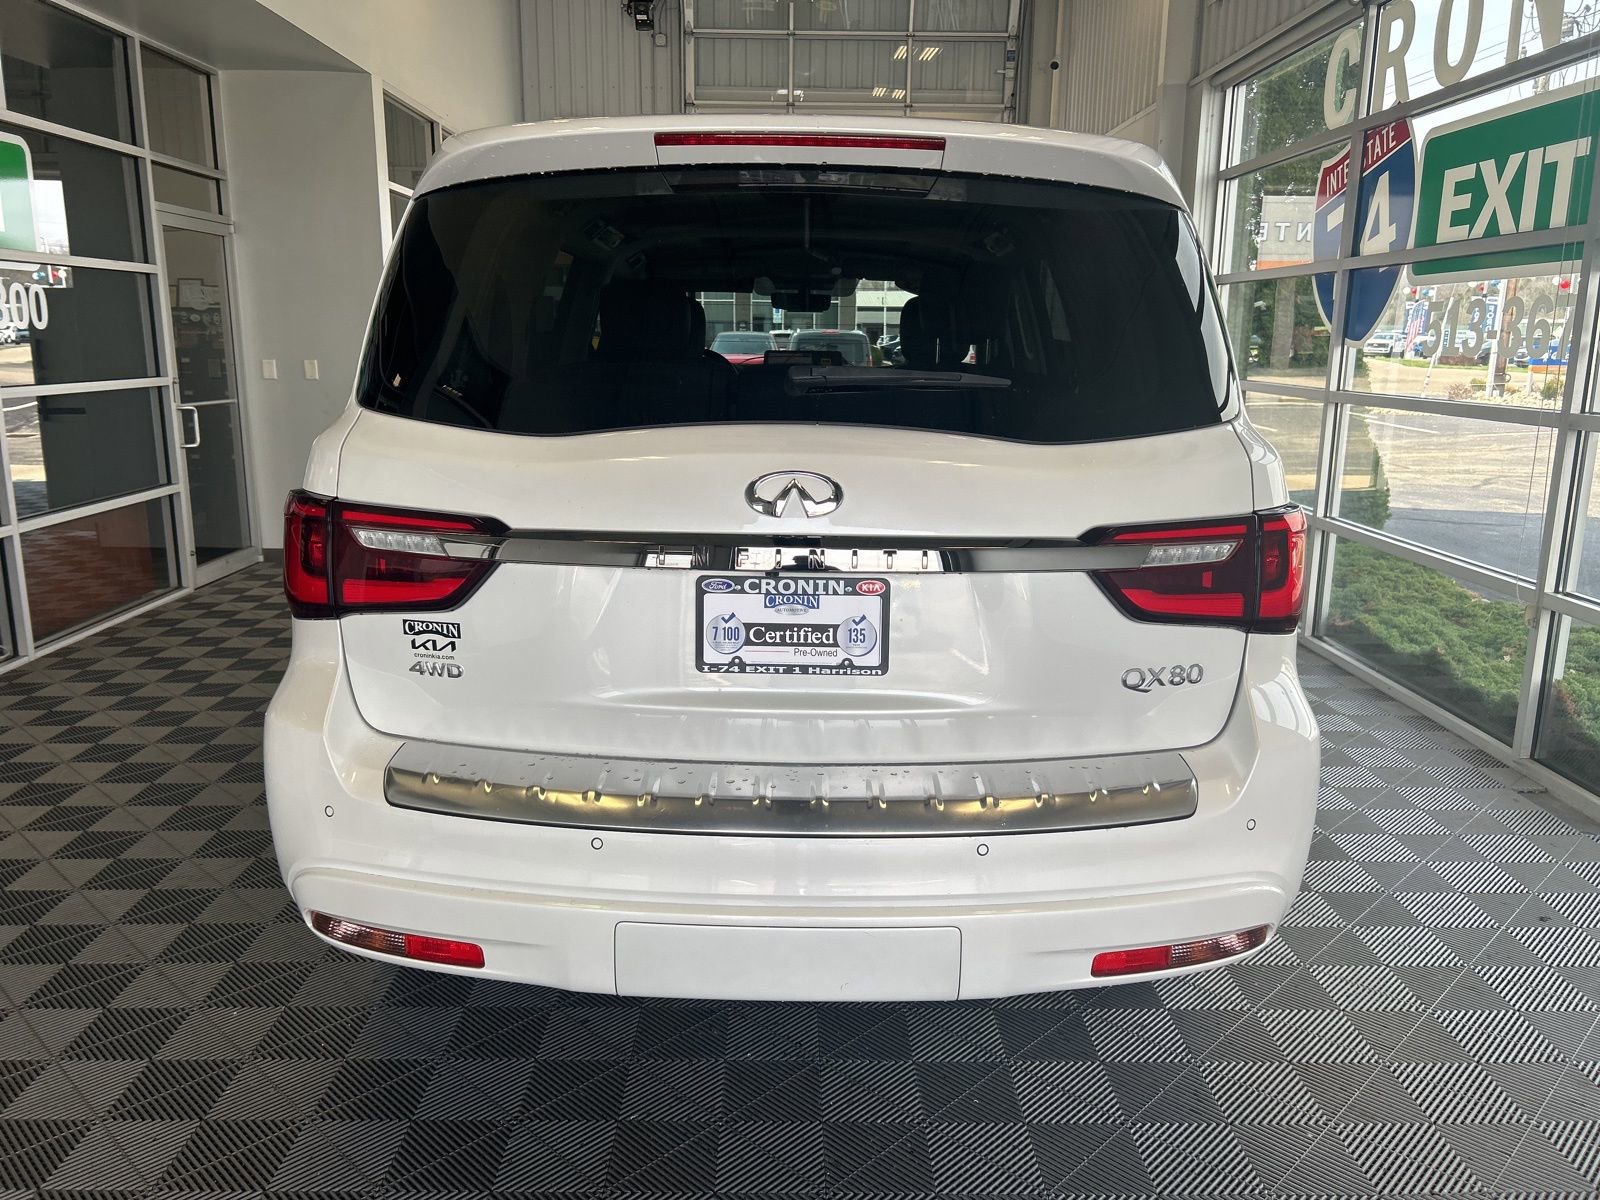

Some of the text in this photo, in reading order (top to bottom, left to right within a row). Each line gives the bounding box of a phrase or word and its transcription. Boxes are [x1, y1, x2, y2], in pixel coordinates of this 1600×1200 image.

[1326, 122, 1397, 198] INTETATE
[1436, 136, 1592, 243] EXIT
[743, 578, 845, 594] CRONIN
[861, 583, 881, 592] KIA
[766, 594, 818, 608] CRONIN
[404, 620, 458, 638] CRONIN
[712, 626, 740, 641] 7 100
[749, 626, 834, 644] Certified
[848, 628, 866, 643] 135
[414, 652, 455, 661] croninkia.com
[793, 647, 838, 657] Pre-Owned
[409, 661, 464, 679] 4WD
[702, 665, 740, 673] I-74
[746, 666, 788, 674] EXIT
[808, 667, 882, 676] Harrison
[1121, 663, 1204, 693] QX80
